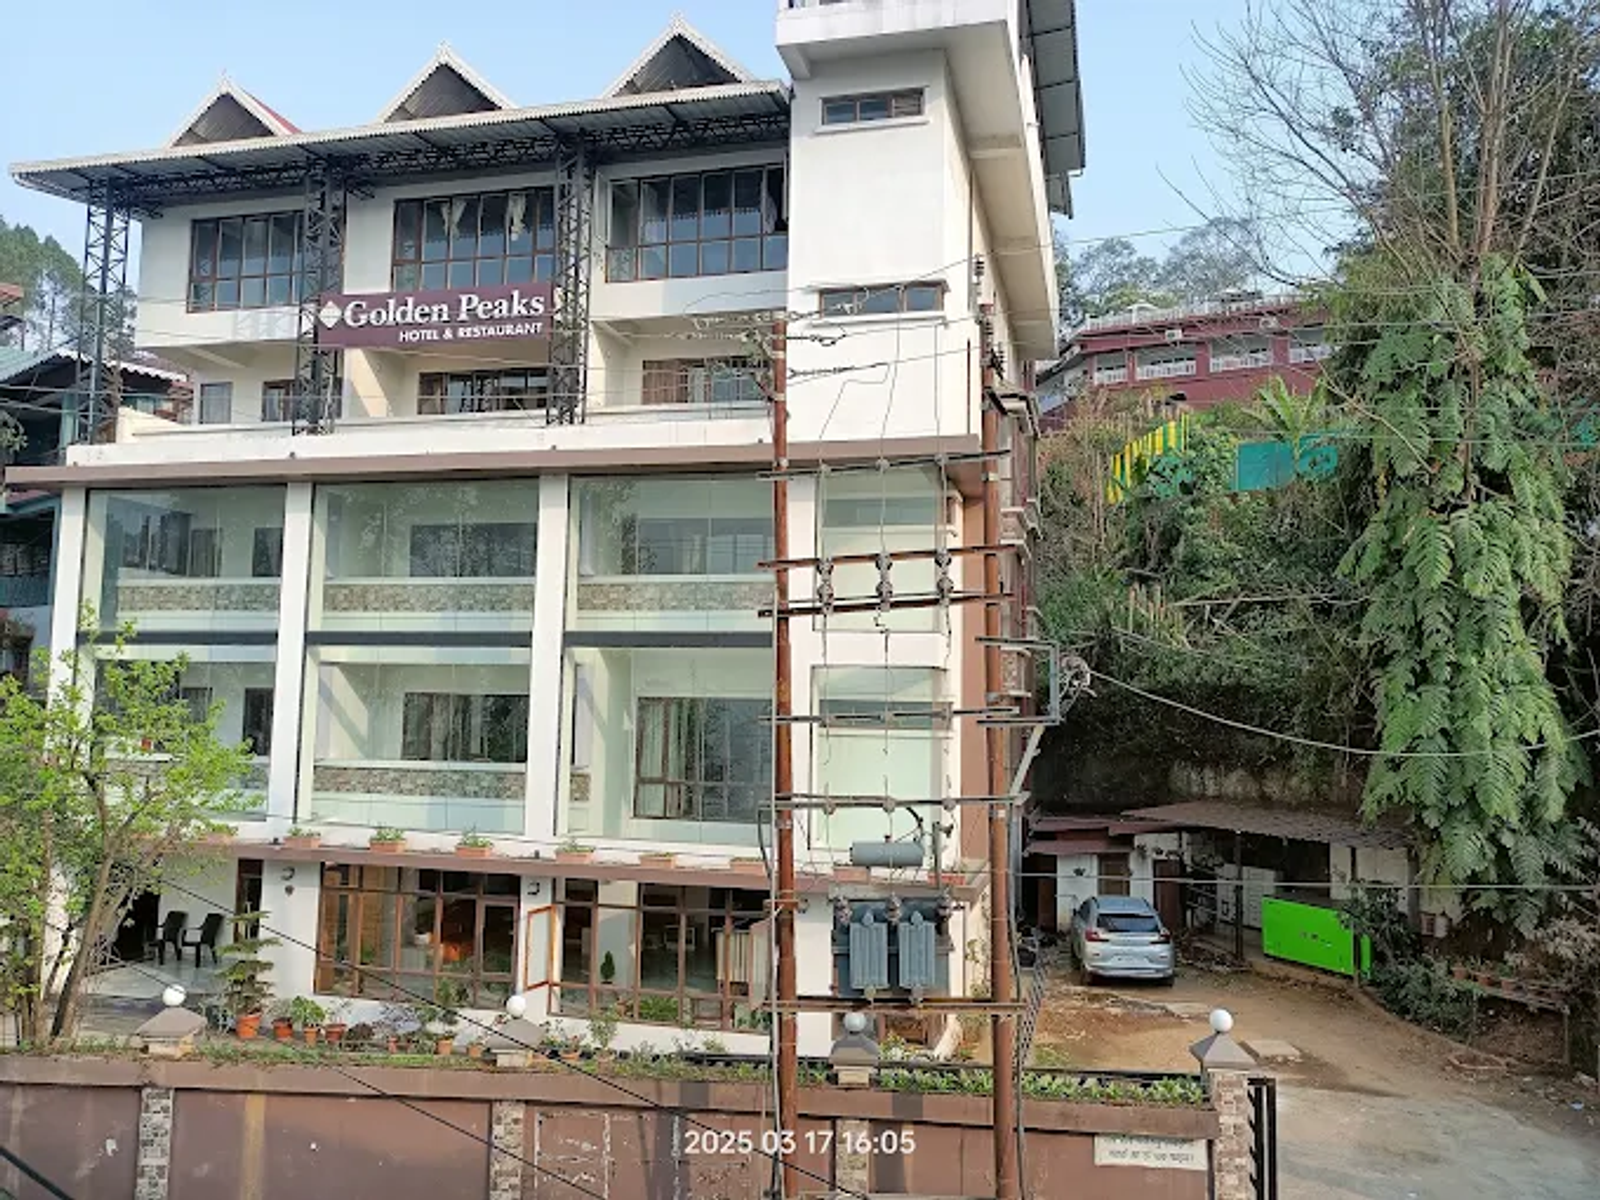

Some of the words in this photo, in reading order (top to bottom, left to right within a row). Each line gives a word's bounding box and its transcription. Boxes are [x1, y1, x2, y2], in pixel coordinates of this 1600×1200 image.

[343, 296, 450, 328] Golden
[457, 290, 545, 322] Peaks
[399, 328, 440, 342] HOTEL
[443, 328, 453, 340] &
[457, 322, 543, 338] RESTAURANT
